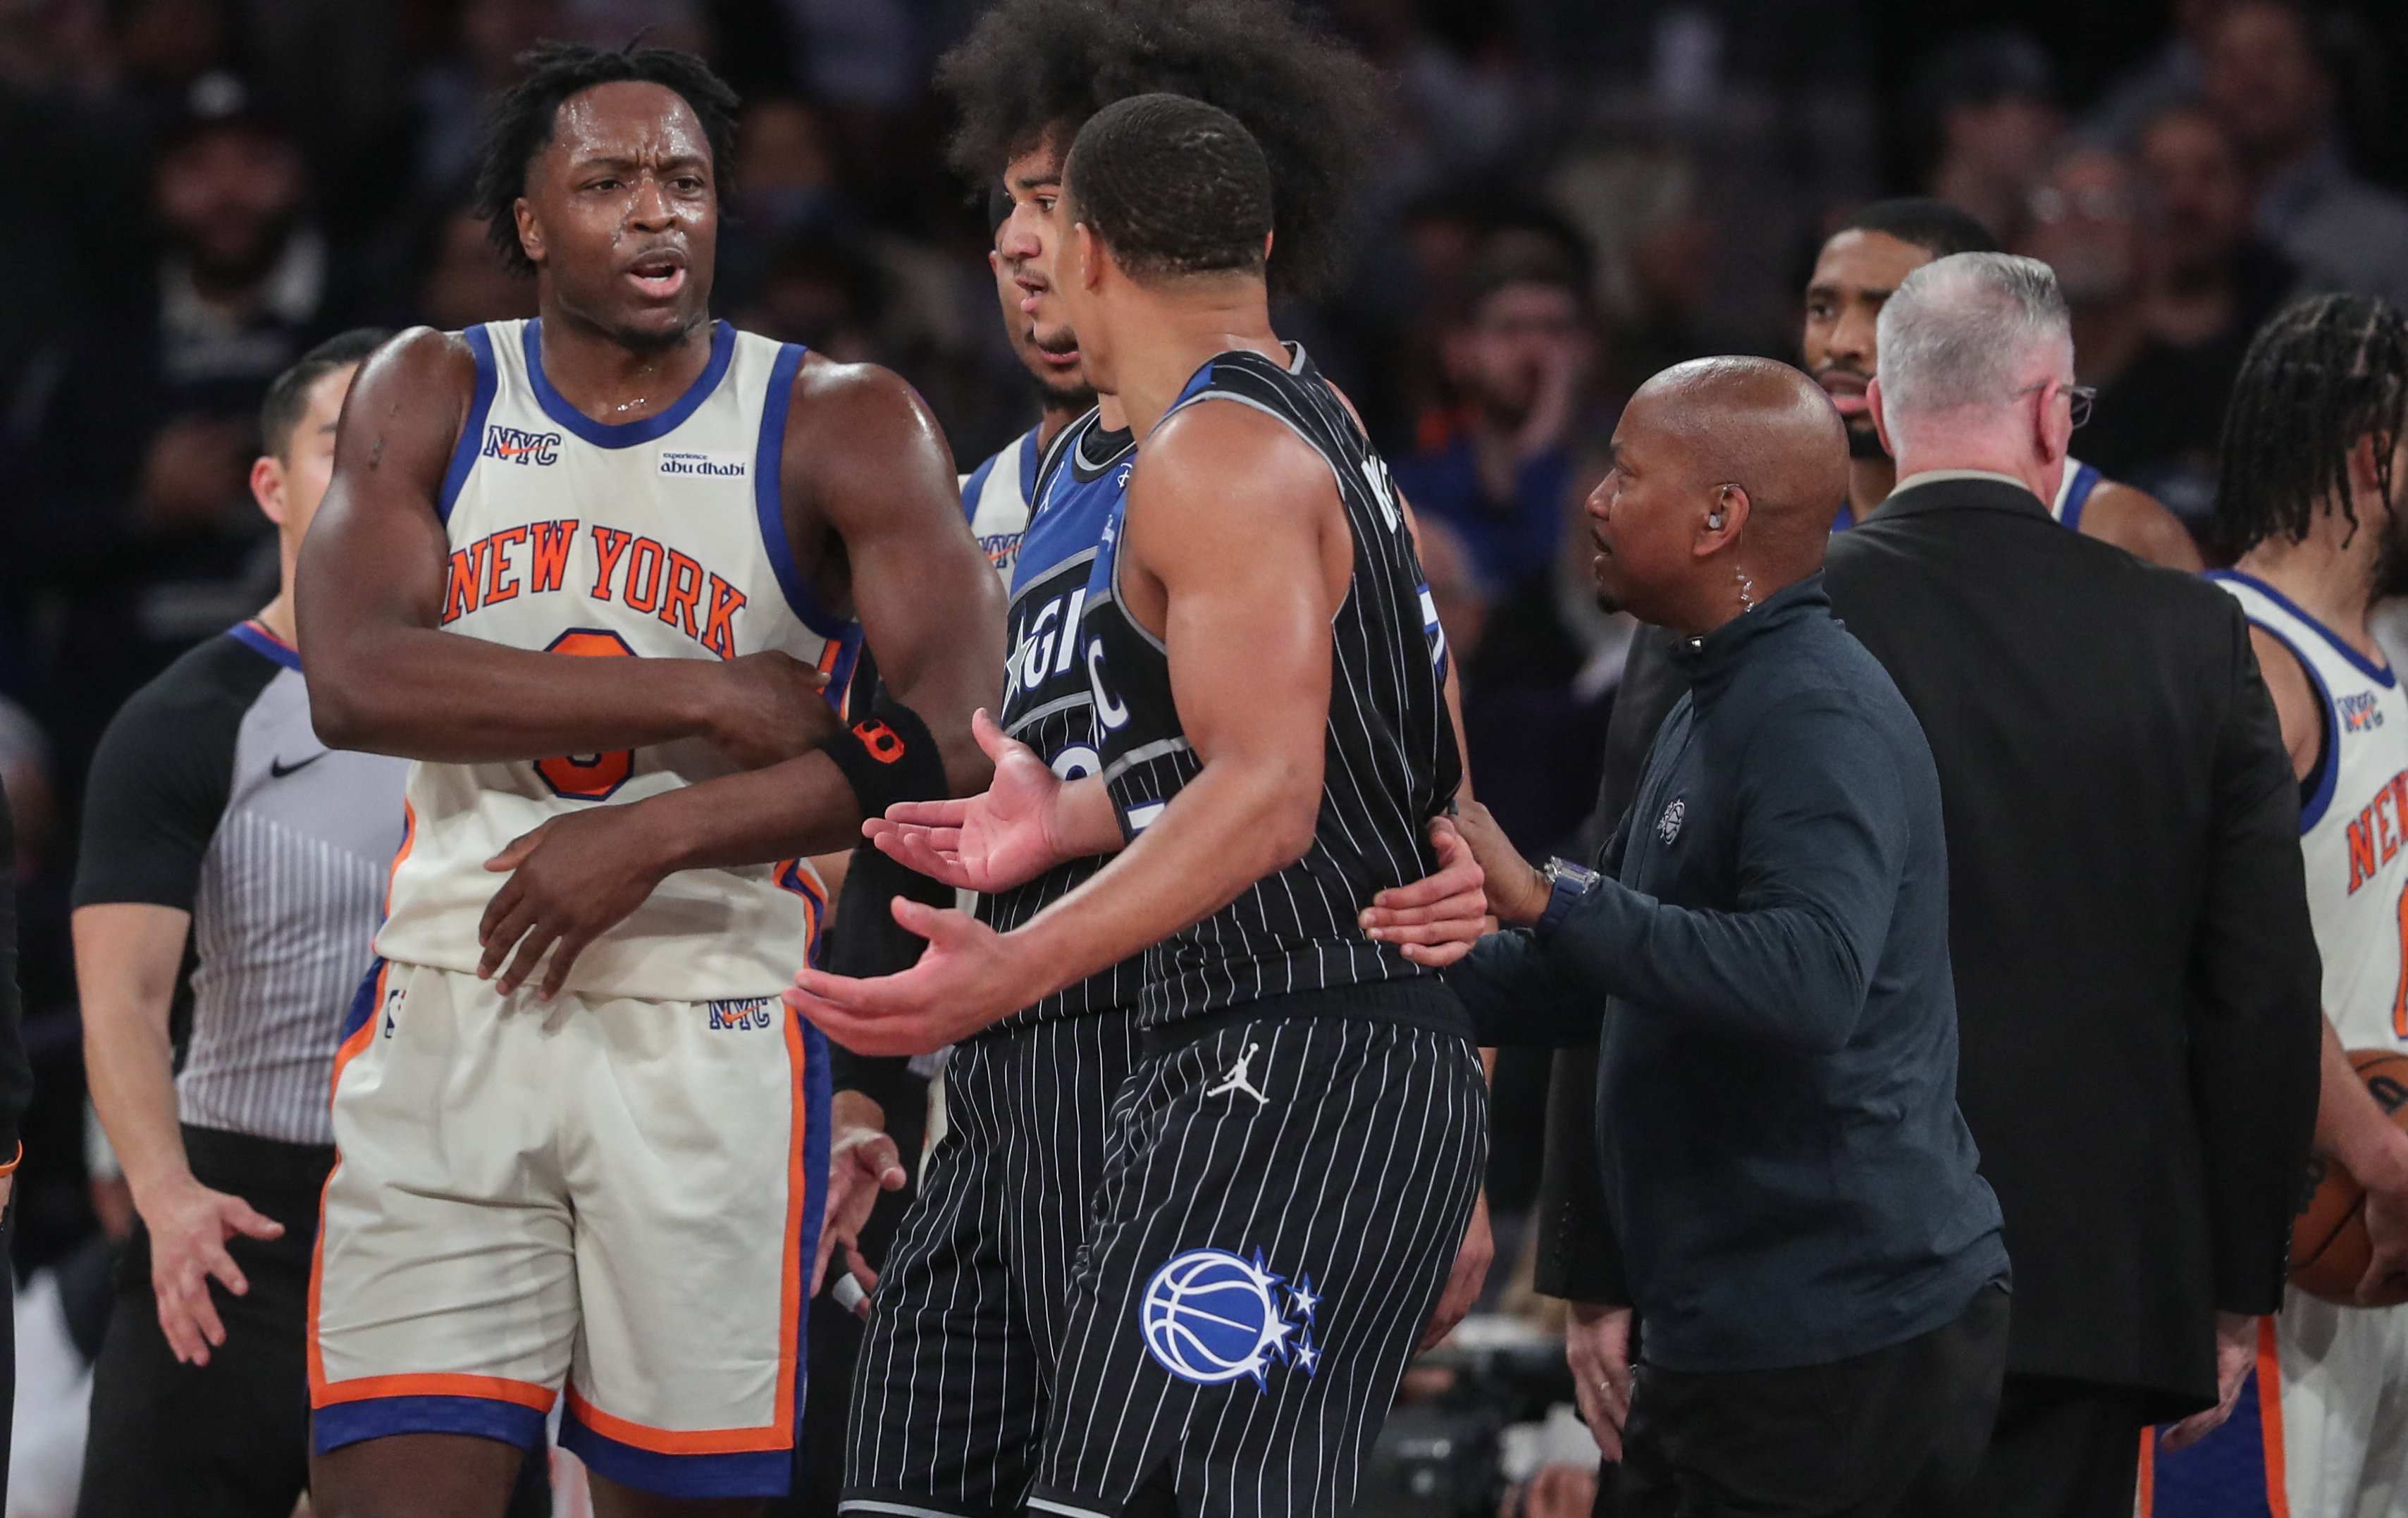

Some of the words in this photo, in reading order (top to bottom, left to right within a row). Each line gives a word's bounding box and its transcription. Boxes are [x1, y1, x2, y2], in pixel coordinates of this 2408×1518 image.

[483, 425, 561, 466] NYC
[661, 460, 693, 473] abu
[696, 462, 746, 475] dhabi
[440, 519, 579, 627] NEW
[591, 524, 748, 661] YORK
[708, 996, 770, 1030] NYC
